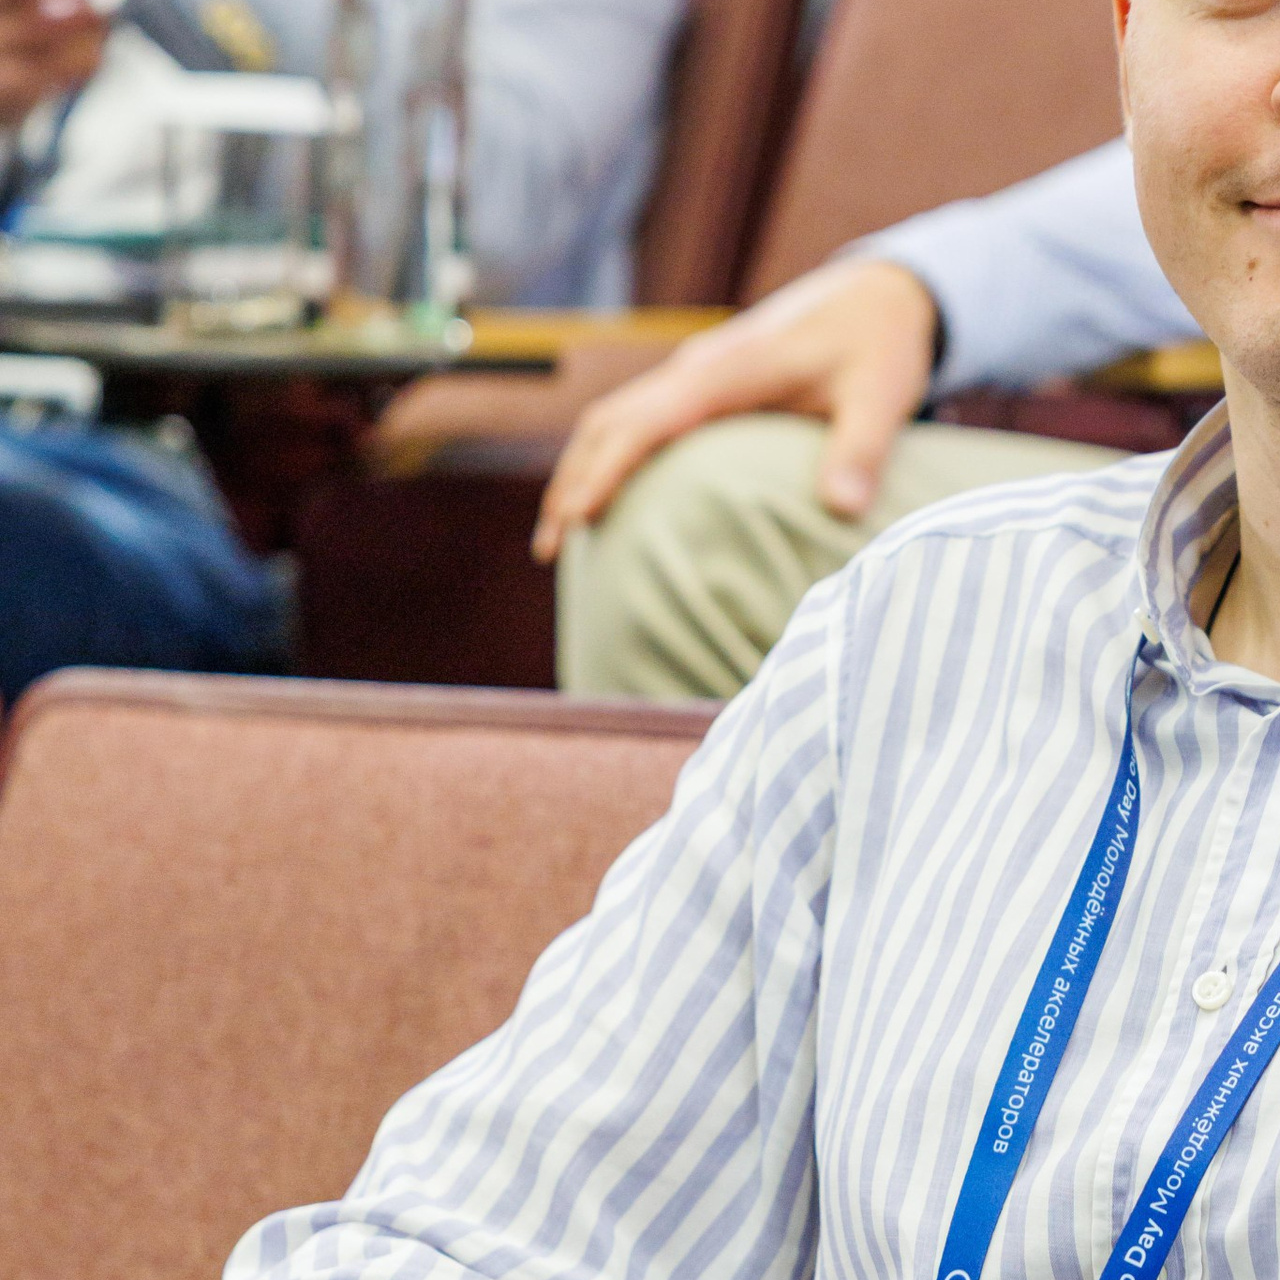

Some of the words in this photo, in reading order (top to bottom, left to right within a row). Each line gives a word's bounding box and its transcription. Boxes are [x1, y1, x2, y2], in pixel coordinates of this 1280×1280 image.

[1117, 779, 1137, 823] Day
[1062, 825, 1129, 975] Молодёжных
[994, 977, 1071, 1154] акселераторов
[1123, 1218, 1164, 1268] Day
[1149, 1057, 1249, 1214] Молодёжных
